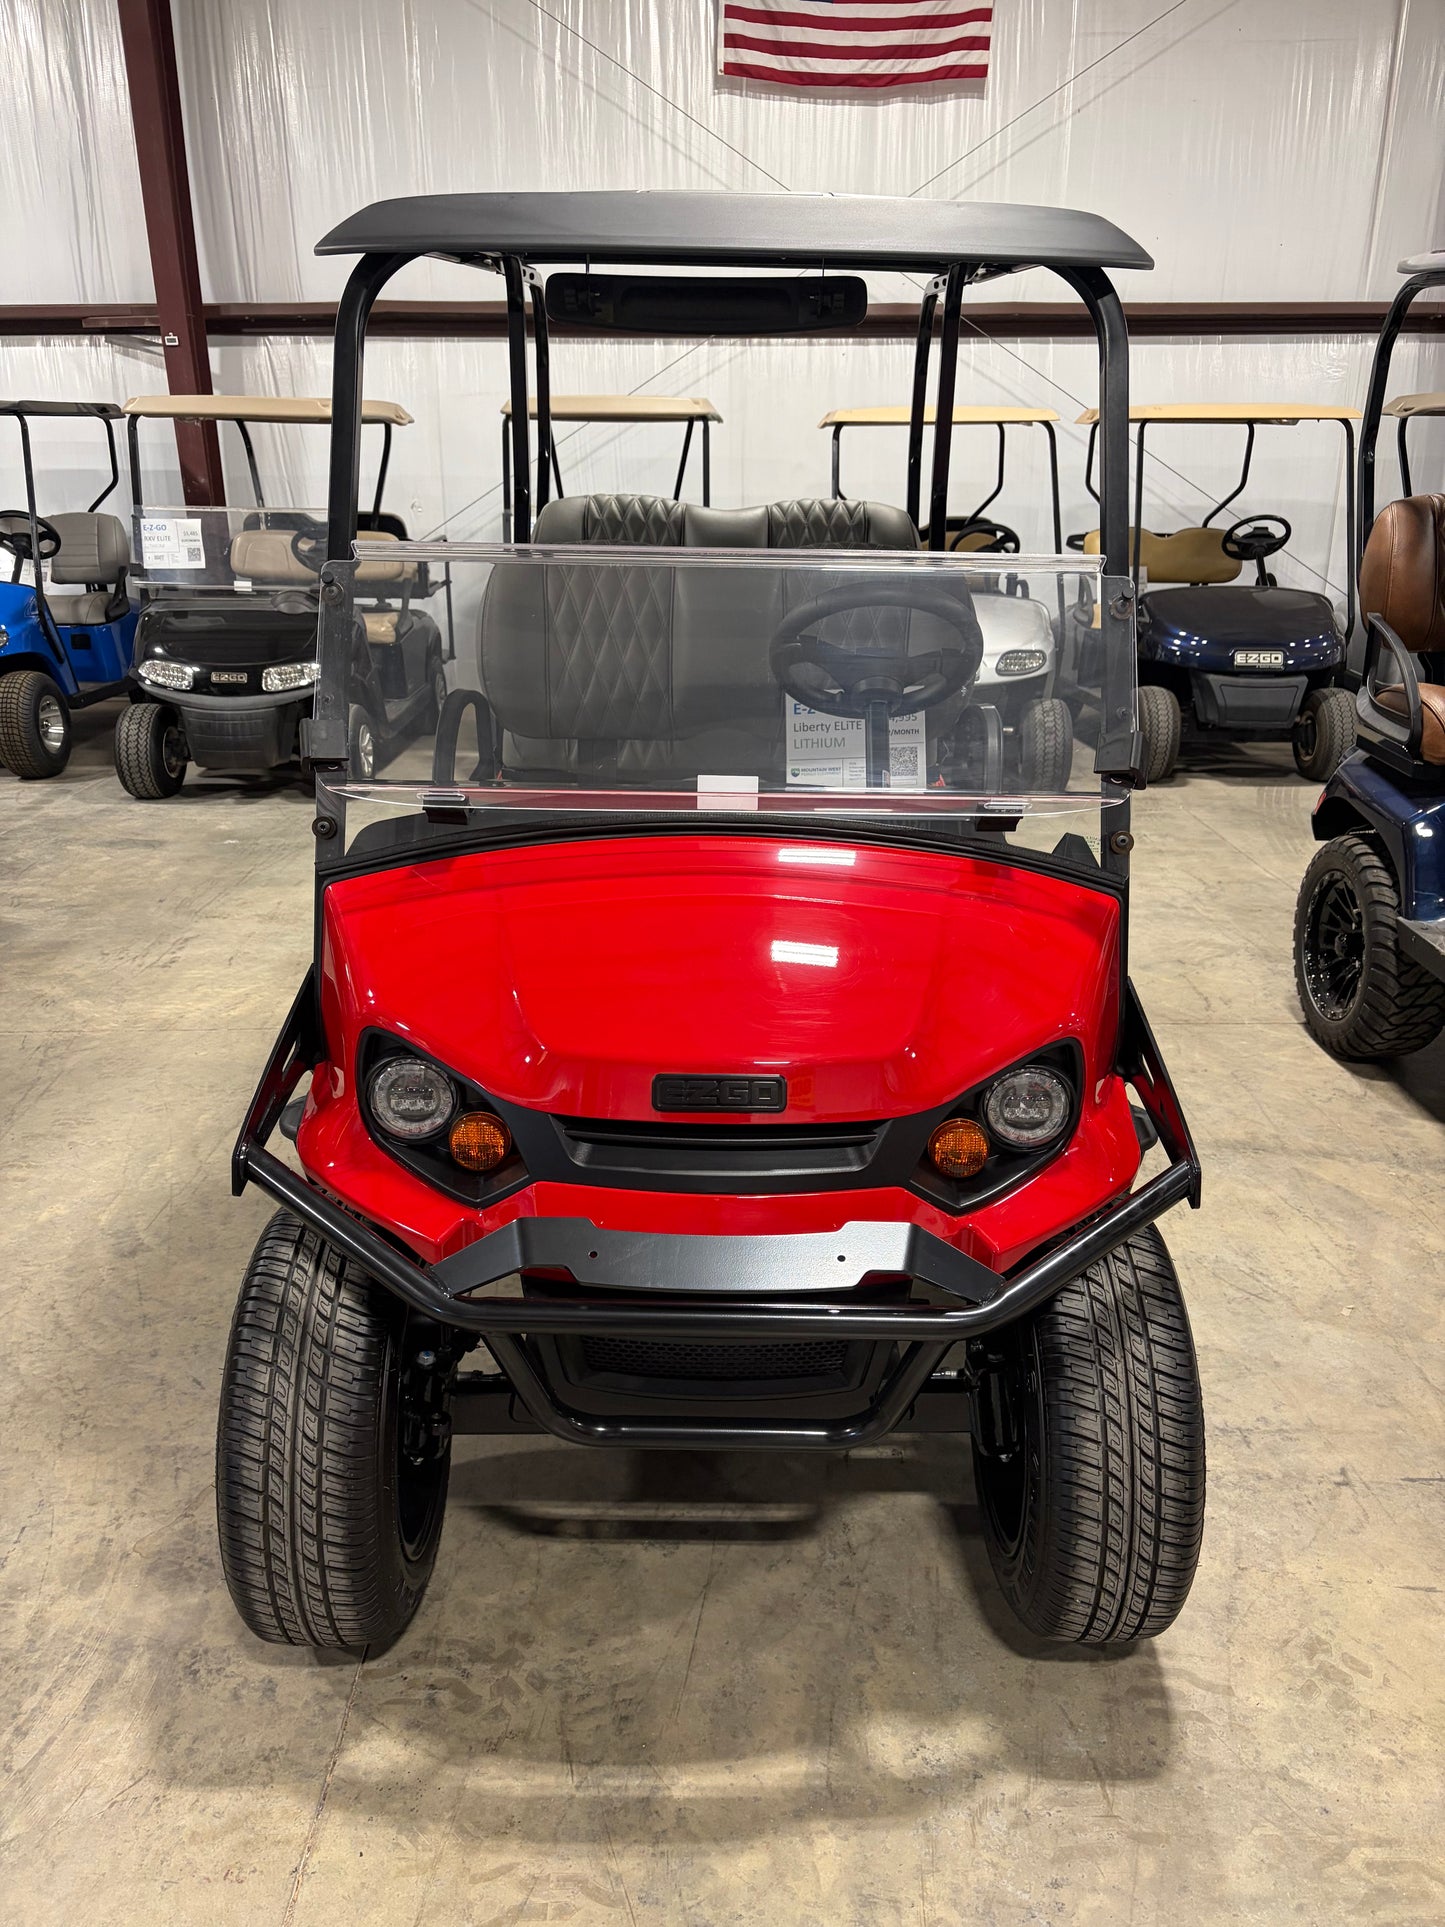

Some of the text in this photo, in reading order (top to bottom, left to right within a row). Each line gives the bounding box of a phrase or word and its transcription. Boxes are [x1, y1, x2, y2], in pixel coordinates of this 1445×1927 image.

[793, 722, 831, 733] Liberty
[793, 737, 846, 750] LITHIUM
[660, 1080, 780, 1105] EZGO
